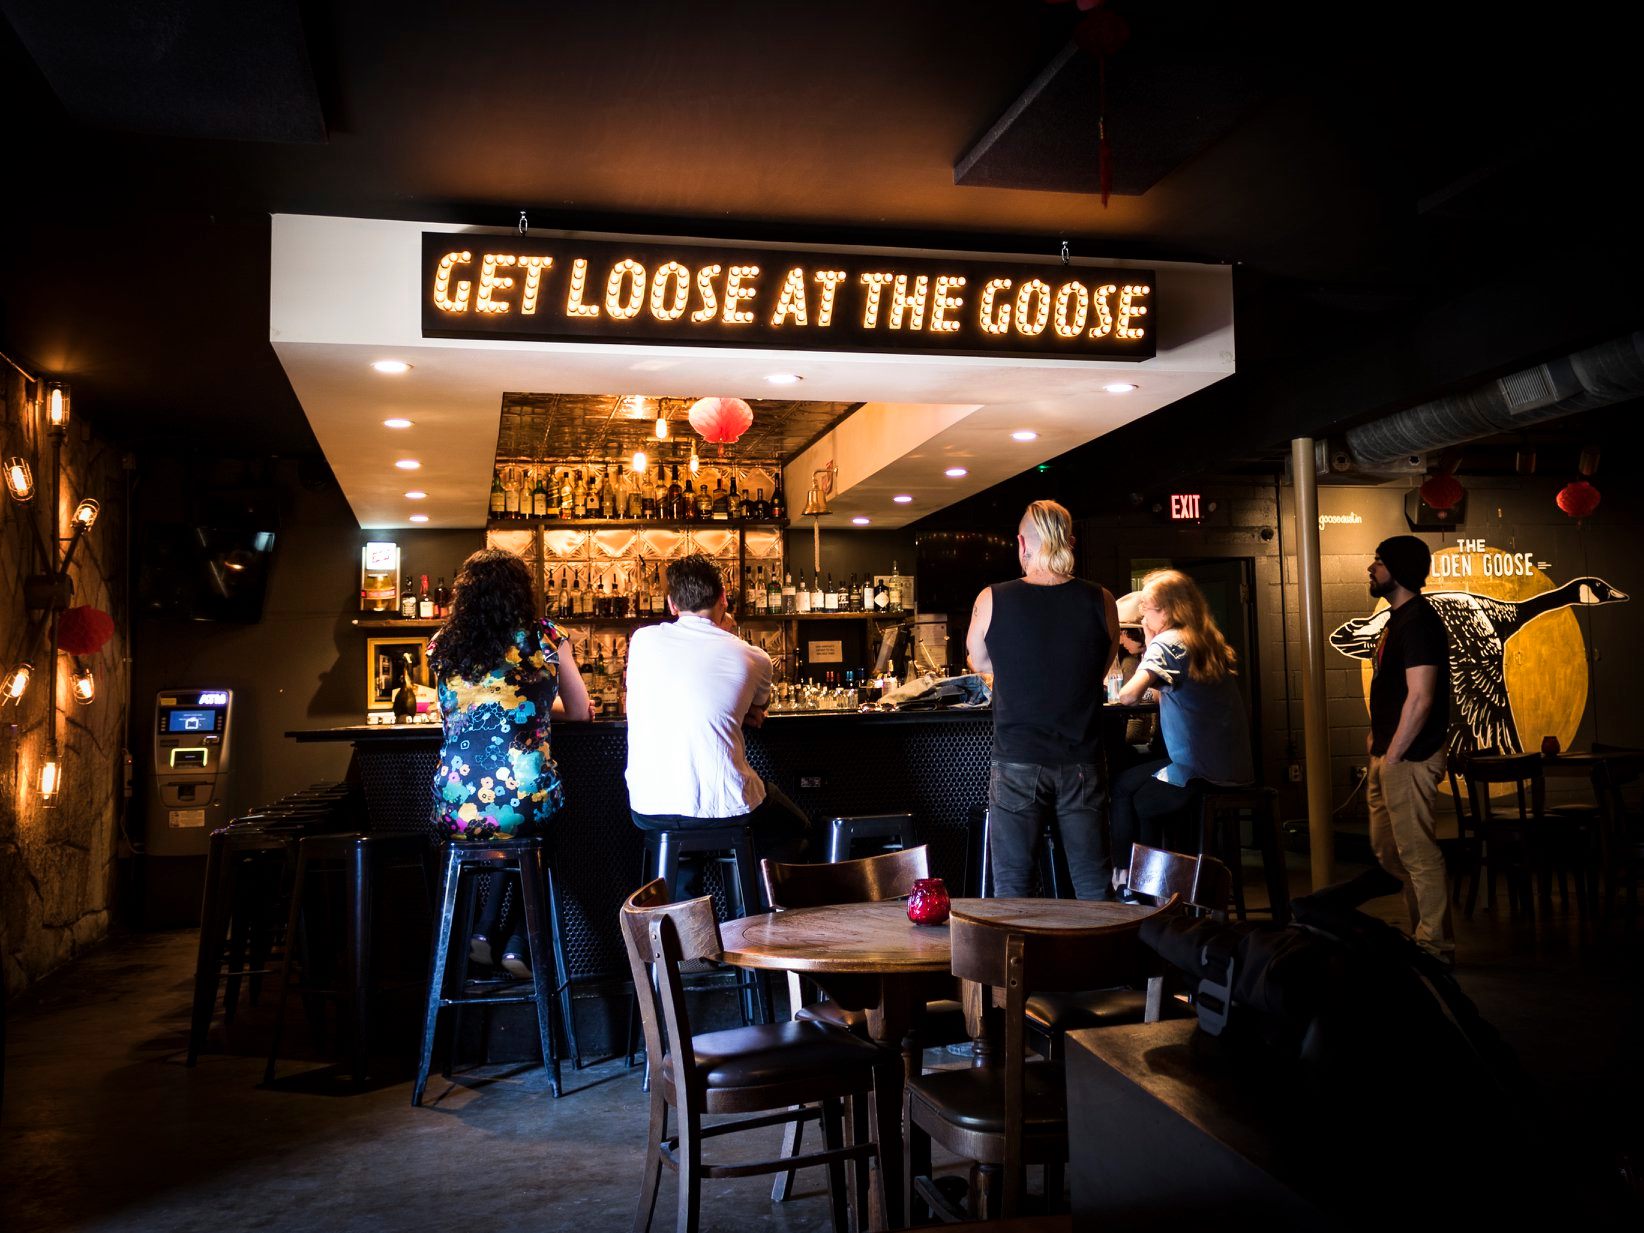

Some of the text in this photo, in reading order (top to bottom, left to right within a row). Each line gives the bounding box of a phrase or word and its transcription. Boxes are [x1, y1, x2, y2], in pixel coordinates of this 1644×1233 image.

[434, 251, 1150, 340] GET LOOSE AT THE GOOSE
[1171, 494, 1201, 519] EXIT
[1456, 538, 1486, 553] THE
[1431, 552, 1534, 577] LDEN GOOSE
